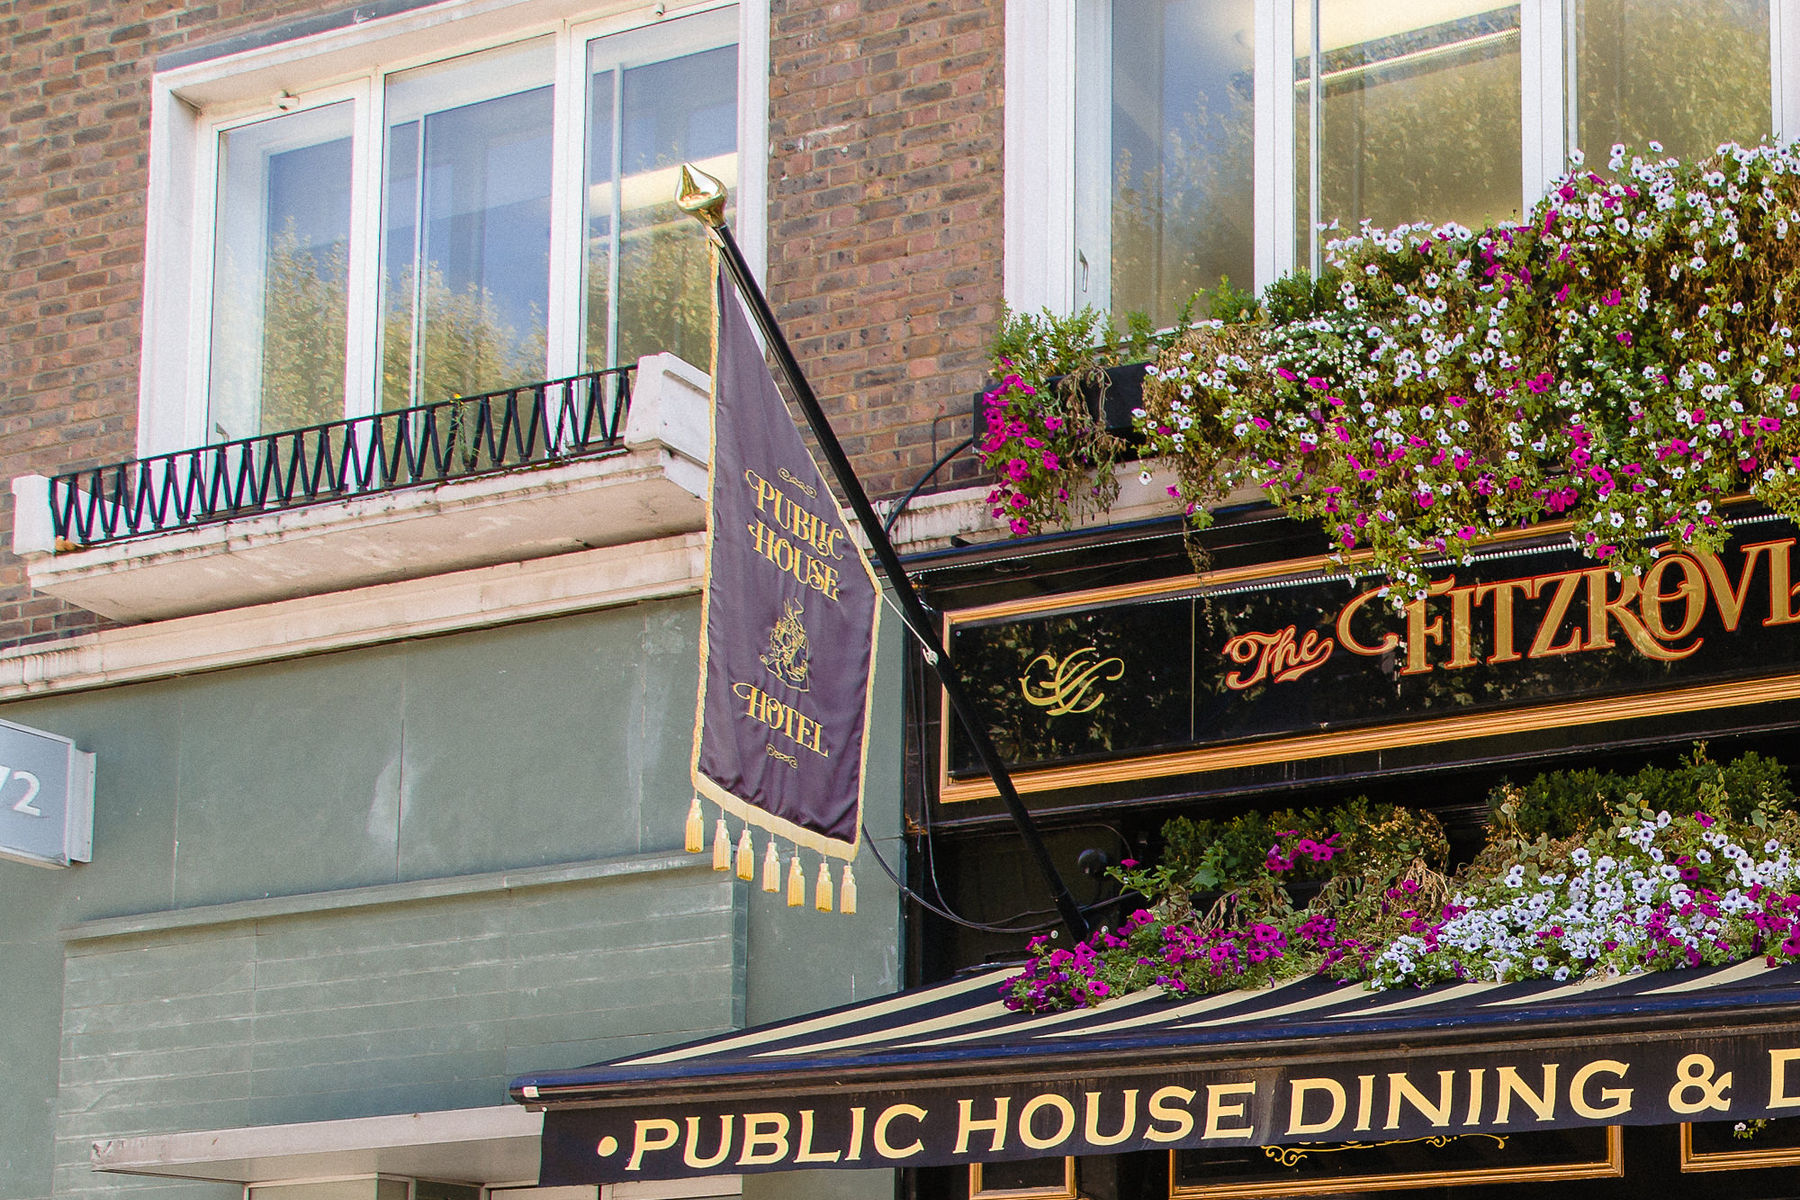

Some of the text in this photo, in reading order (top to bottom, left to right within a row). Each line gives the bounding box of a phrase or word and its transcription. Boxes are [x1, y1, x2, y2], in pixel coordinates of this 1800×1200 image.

[745, 469, 845, 560] PUBLIC
[747, 519, 840, 601] HOUSE
[1222, 624, 1336, 691] The
[733, 682, 829, 758] HOTEL
[626, 1103, 928, 1171] PUBLIC
[951, 1081, 1256, 1154] HOUSE
[1285, 1058, 1632, 1136] DINING
[1668, 1053, 1732, 1112] &
